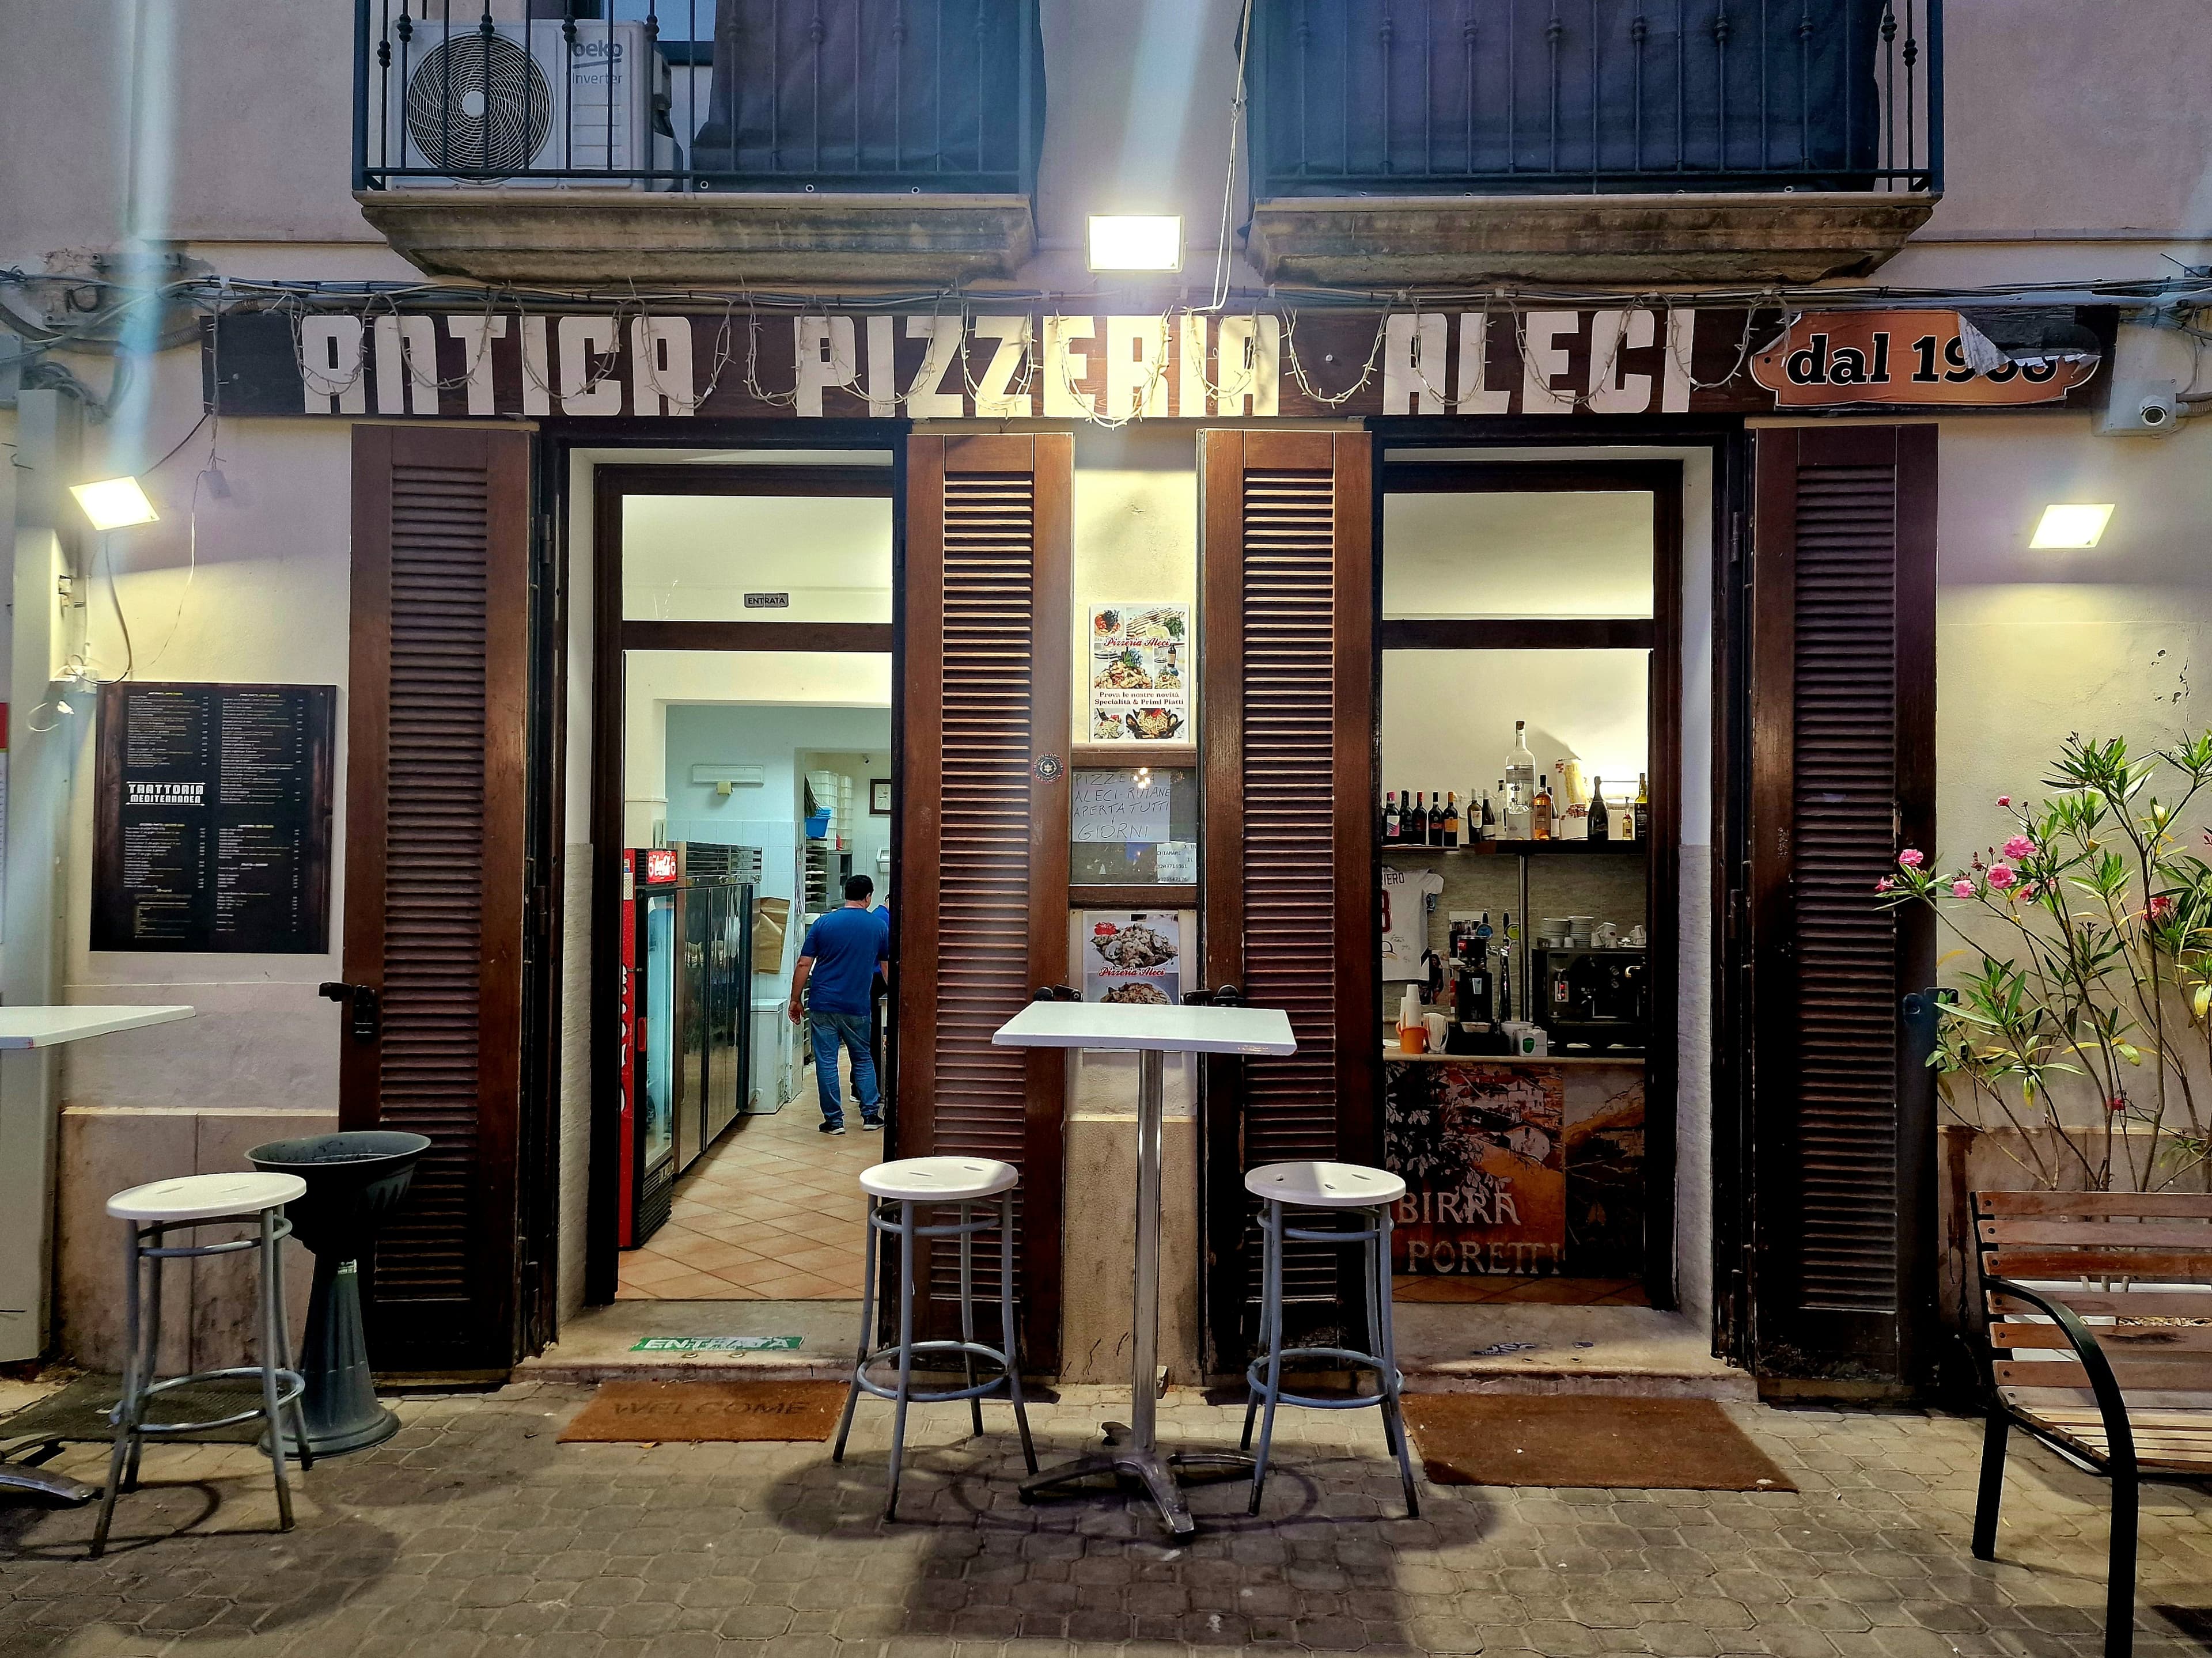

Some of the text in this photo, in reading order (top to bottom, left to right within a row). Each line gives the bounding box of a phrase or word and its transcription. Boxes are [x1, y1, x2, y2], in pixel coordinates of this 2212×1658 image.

[302, 309, 1695, 418] ANTICA PIZZERIA ALECI
[1786, 332, 1890, 386] dal
[1104, 636, 1171, 647] Pizzeria Aleci
[128, 784, 204, 795] TRATTORIA
[1074, 801, 1169, 817] APERTA TUTTI
[1078, 822, 1148, 840] GIORNI
[1099, 966, 1166, 977] Pizzeria Aleci
[1397, 1191, 1521, 1226] BIRRA
[1407, 1240, 1560, 1275] PORETTI
